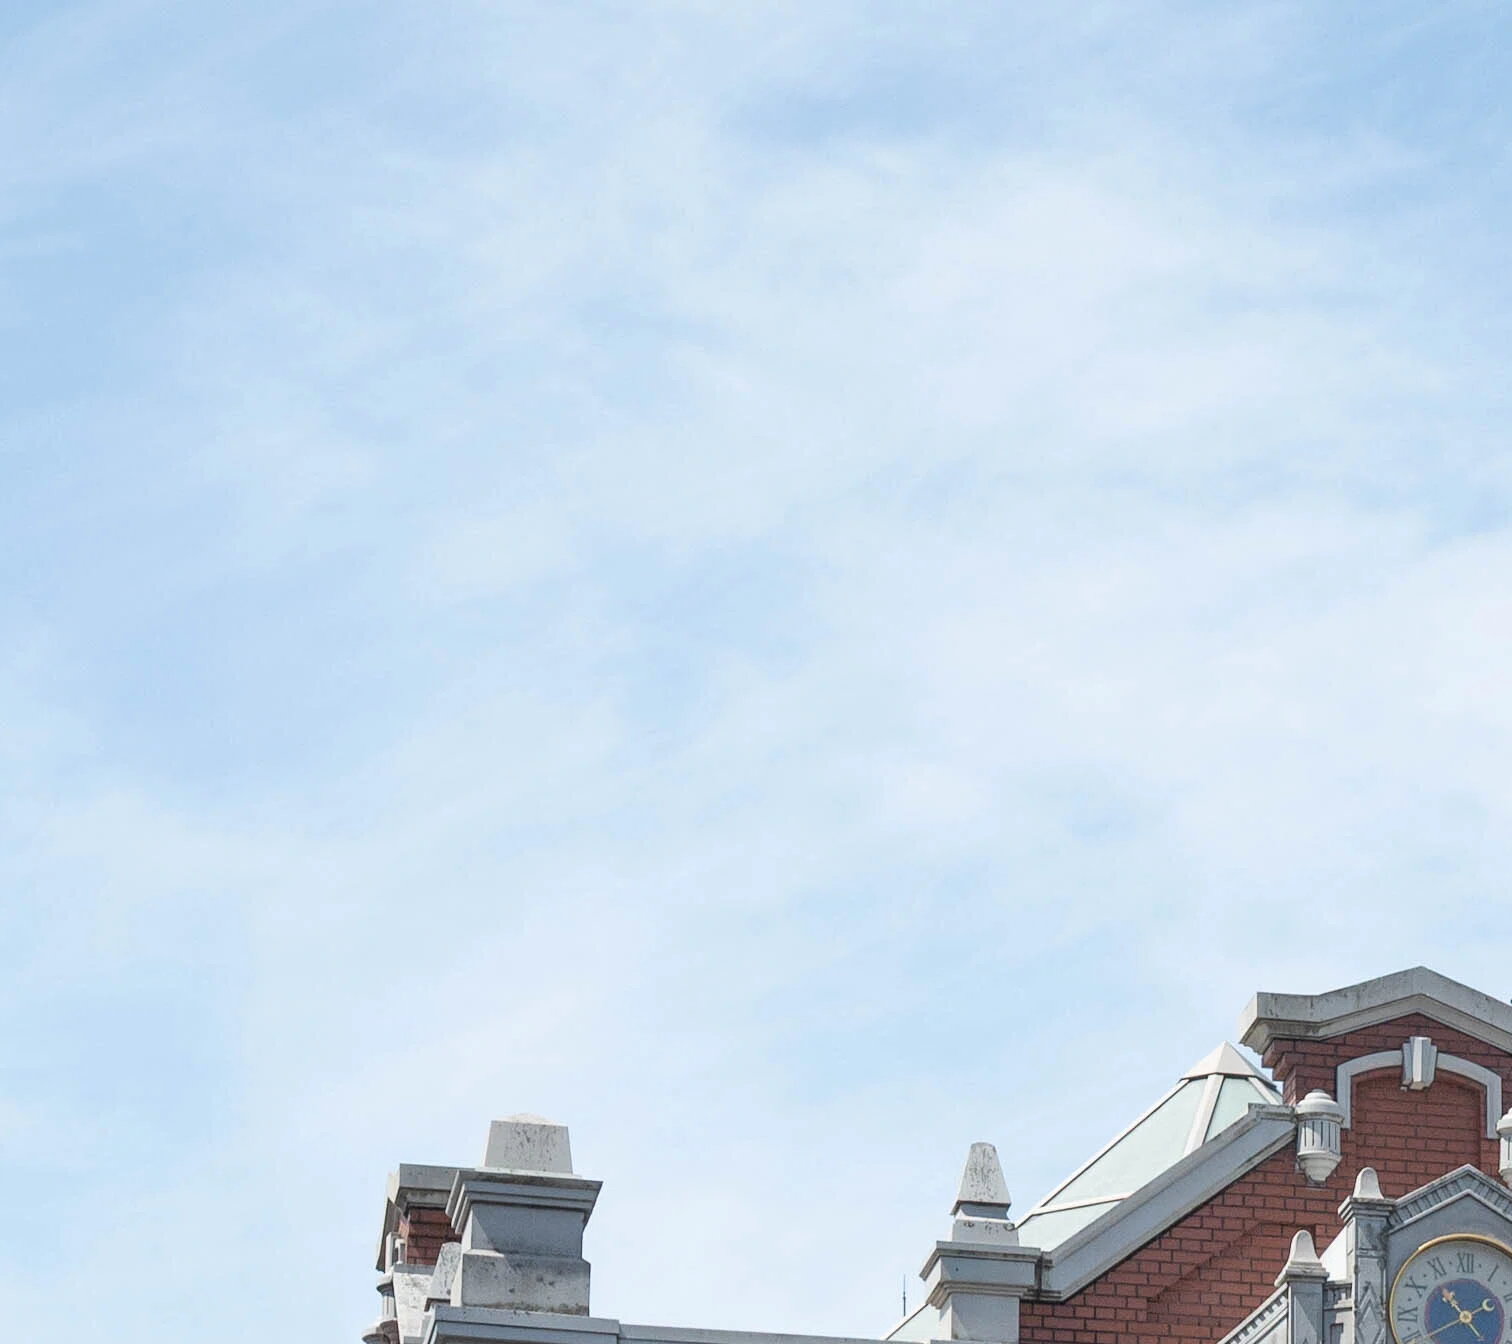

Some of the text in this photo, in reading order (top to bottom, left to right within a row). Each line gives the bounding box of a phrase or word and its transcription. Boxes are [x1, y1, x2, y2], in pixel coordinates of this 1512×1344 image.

[1428, 1256, 1447, 1280] XI
[1456, 1252, 1474, 1273] XII
[1404, 1276, 1428, 1298] X
[1398, 1306, 1418, 1322] IX
